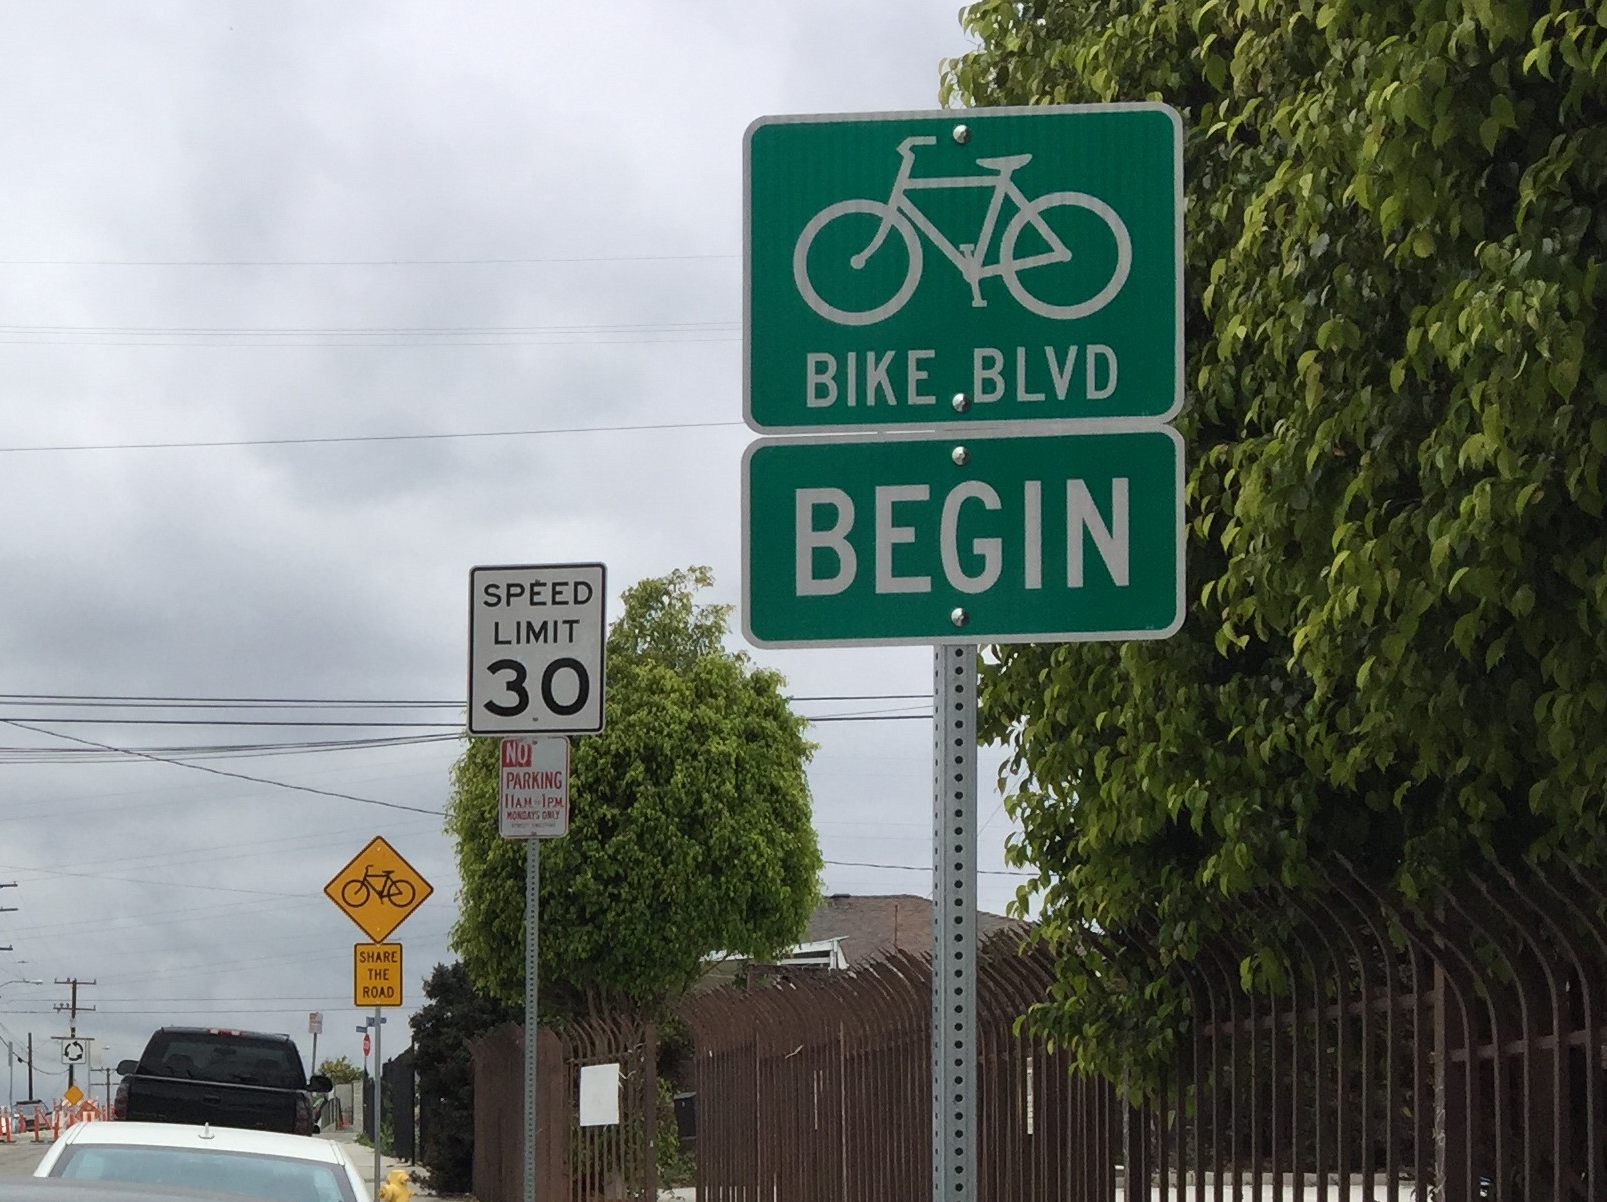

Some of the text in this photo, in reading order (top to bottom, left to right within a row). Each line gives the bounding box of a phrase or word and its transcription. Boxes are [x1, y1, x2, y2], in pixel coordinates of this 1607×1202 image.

[806, 344, 1118, 408] BIKE BLVD
[795, 477, 1130, 597] BEGIN
[483, 580, 593, 607] SPEED
[494, 619, 580, 645] LIMIT
[483, 657, 590, 717] 30
[506, 741, 529, 764] NO
[506, 771, 562, 790] PARKING
[506, 810, 560, 820] MONDAYS ONLY
[359, 951, 398, 963] SHARE
[368, 969, 389, 981] THE
[363, 986, 394, 998] ROAD
